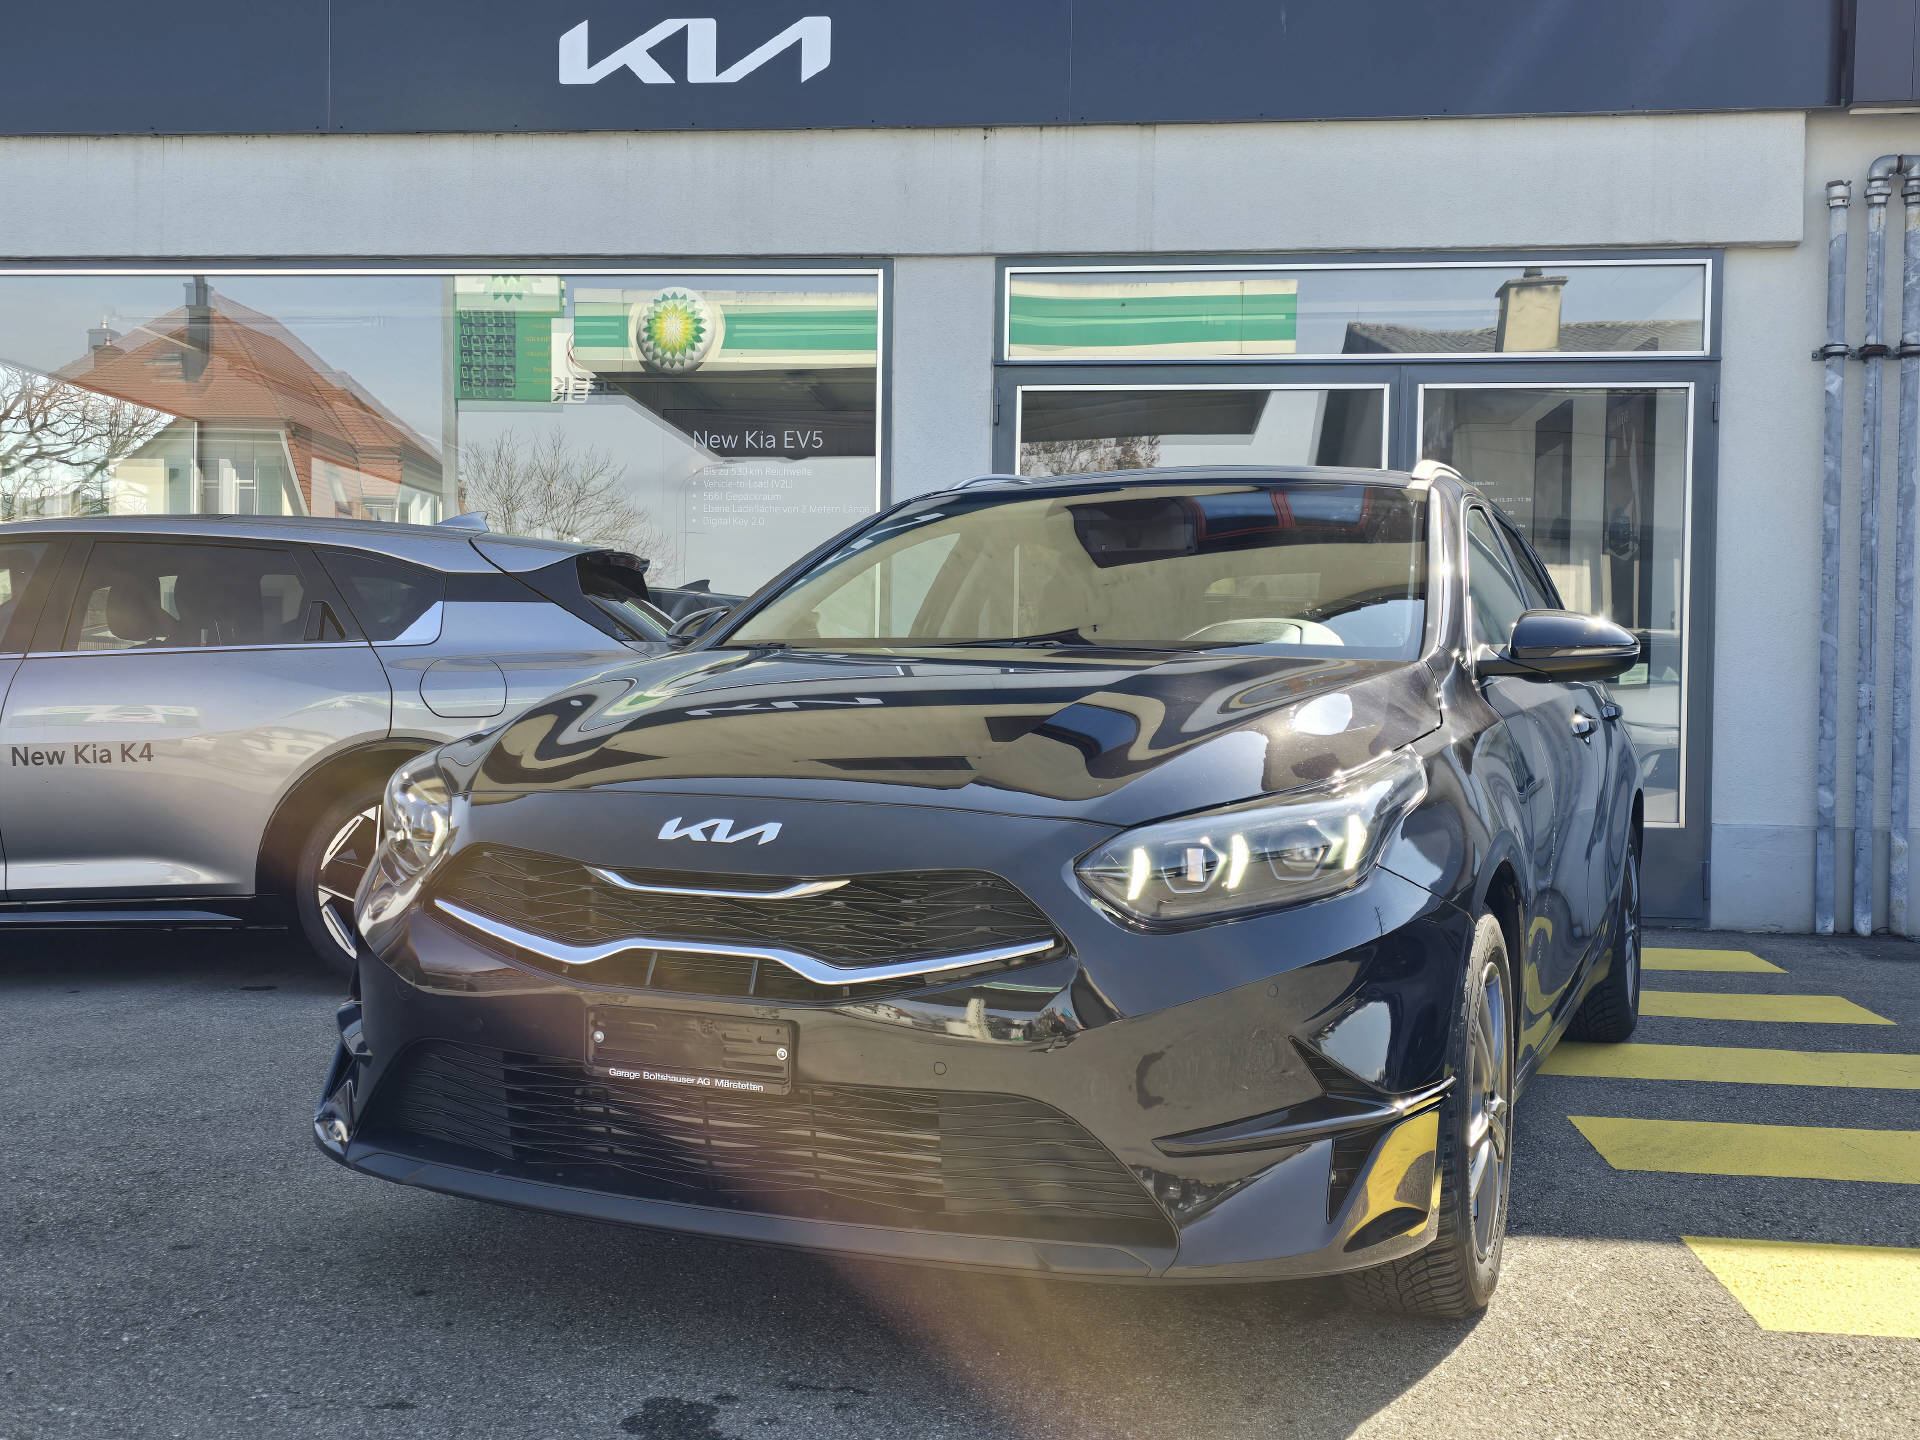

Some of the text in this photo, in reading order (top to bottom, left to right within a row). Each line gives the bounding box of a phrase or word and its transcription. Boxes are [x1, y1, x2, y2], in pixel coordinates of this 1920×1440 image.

[559, 16, 831, 84] KIA
[693, 430, 823, 449] New Kia EV5
[11, 742, 154, 767] New Kia K4
[658, 817, 783, 846] KIA
[608, 1068, 641, 1080] Garage
[696, 1077, 711, 1087] AG
